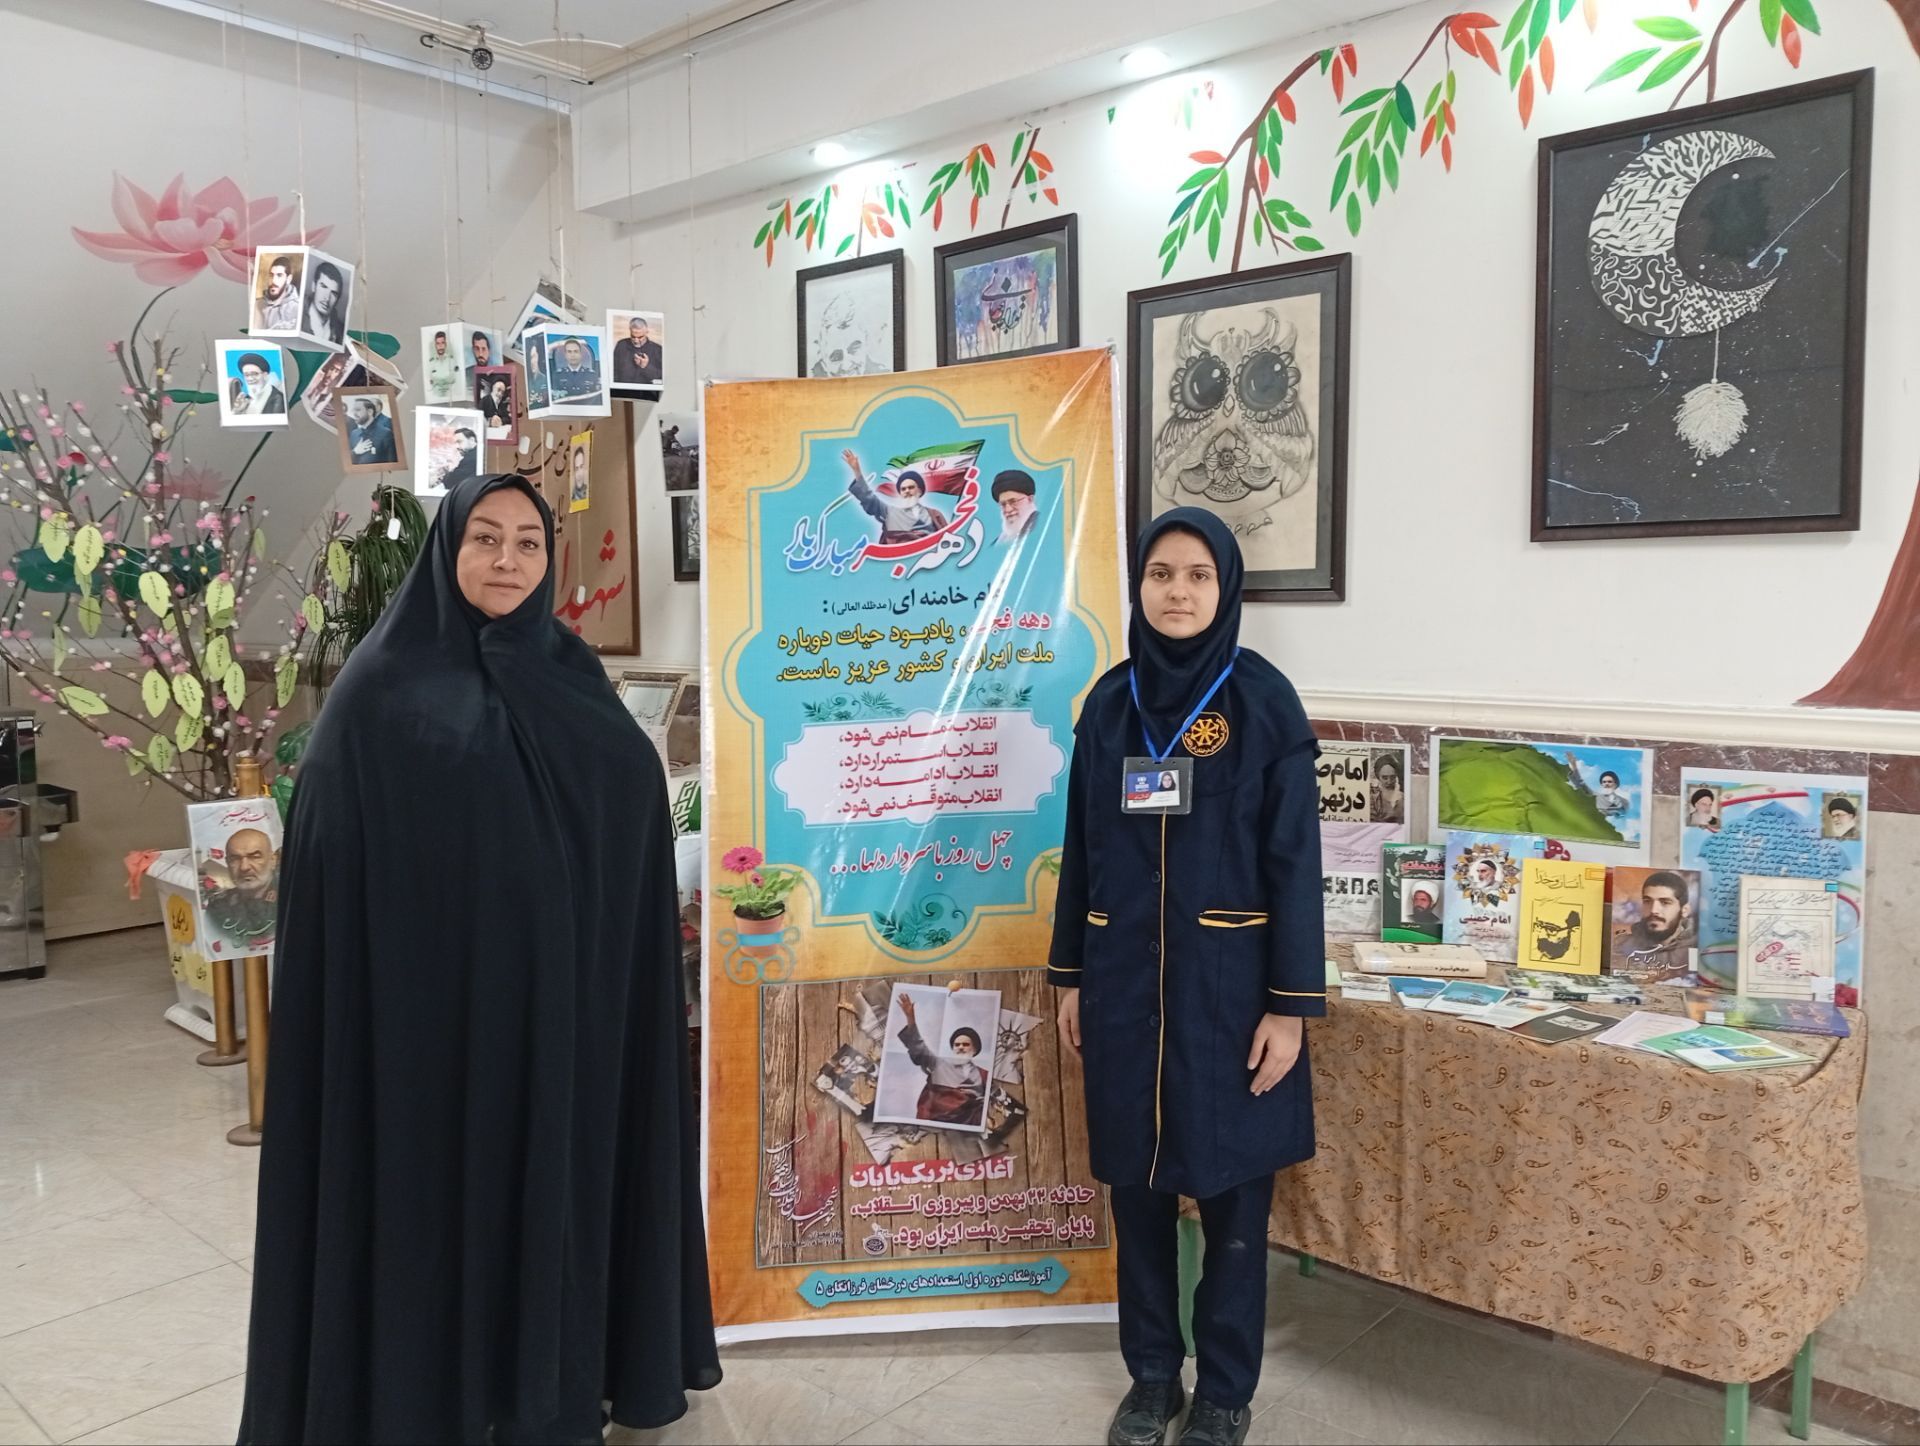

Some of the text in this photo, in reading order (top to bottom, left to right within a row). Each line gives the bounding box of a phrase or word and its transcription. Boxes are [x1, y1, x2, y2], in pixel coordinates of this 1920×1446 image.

[850, 467, 984, 579] دهه فجر
[892, 588, 915, 615] ای
[919, 586, 968, 606] خامنه
[890, 617, 955, 648] یادبود
[1018, 612, 1052, 629] دهه
[777, 627, 832, 656] دوباره
[836, 623, 885, 650] حیات
[1016, 641, 1054, 663] ملت
[776, 658, 841, 682] ماست.
[844, 659, 890, 685] عزیز
[894, 649, 948, 682] کشور
[953, 716, 997, 736] انقلاب
[869, 743, 947, 771] استمرار
[946, 742, 998, 762] انقلاب
[873, 765, 945, 787] ادامه
[946, 764, 998, 785] انقلاب
[1331, 757, 1369, 786] امام
[958, 788, 1002, 808] انقلاب
[1341, 791, 1366, 813] در
[933, 840, 944, 880] با
[943, 835, 973, 865] روز
[974, 830, 1013, 872] چهل
[849, 1166, 901, 1191] پایان
[953, 1155, 1018, 1183] آغازی
[851, 1193, 921, 1218] انقلاب،
[923, 1193, 975, 1218] پیروزی
[989, 1193, 1026, 1212] بهمن
[1050, 1184, 1095, 1206] حادثه
[893, 1227, 923, 1250] بود.
[924, 1222, 963, 1248] ایران
[966, 1221, 998, 1241] ملت
[1000, 1219, 1055, 1243] تحقیر
[1058, 1215, 1096, 1239] پایان
[826, 1279, 867, 1297] فرزانگان
[868, 1277, 907, 1295] درخشان
[909, 1275, 964, 1293] استعدادهای
[964, 1273, 983, 1289] اول
[983, 1273, 1007, 1289] دوره
[1008, 1267, 1053, 1286] آموزشگاه
